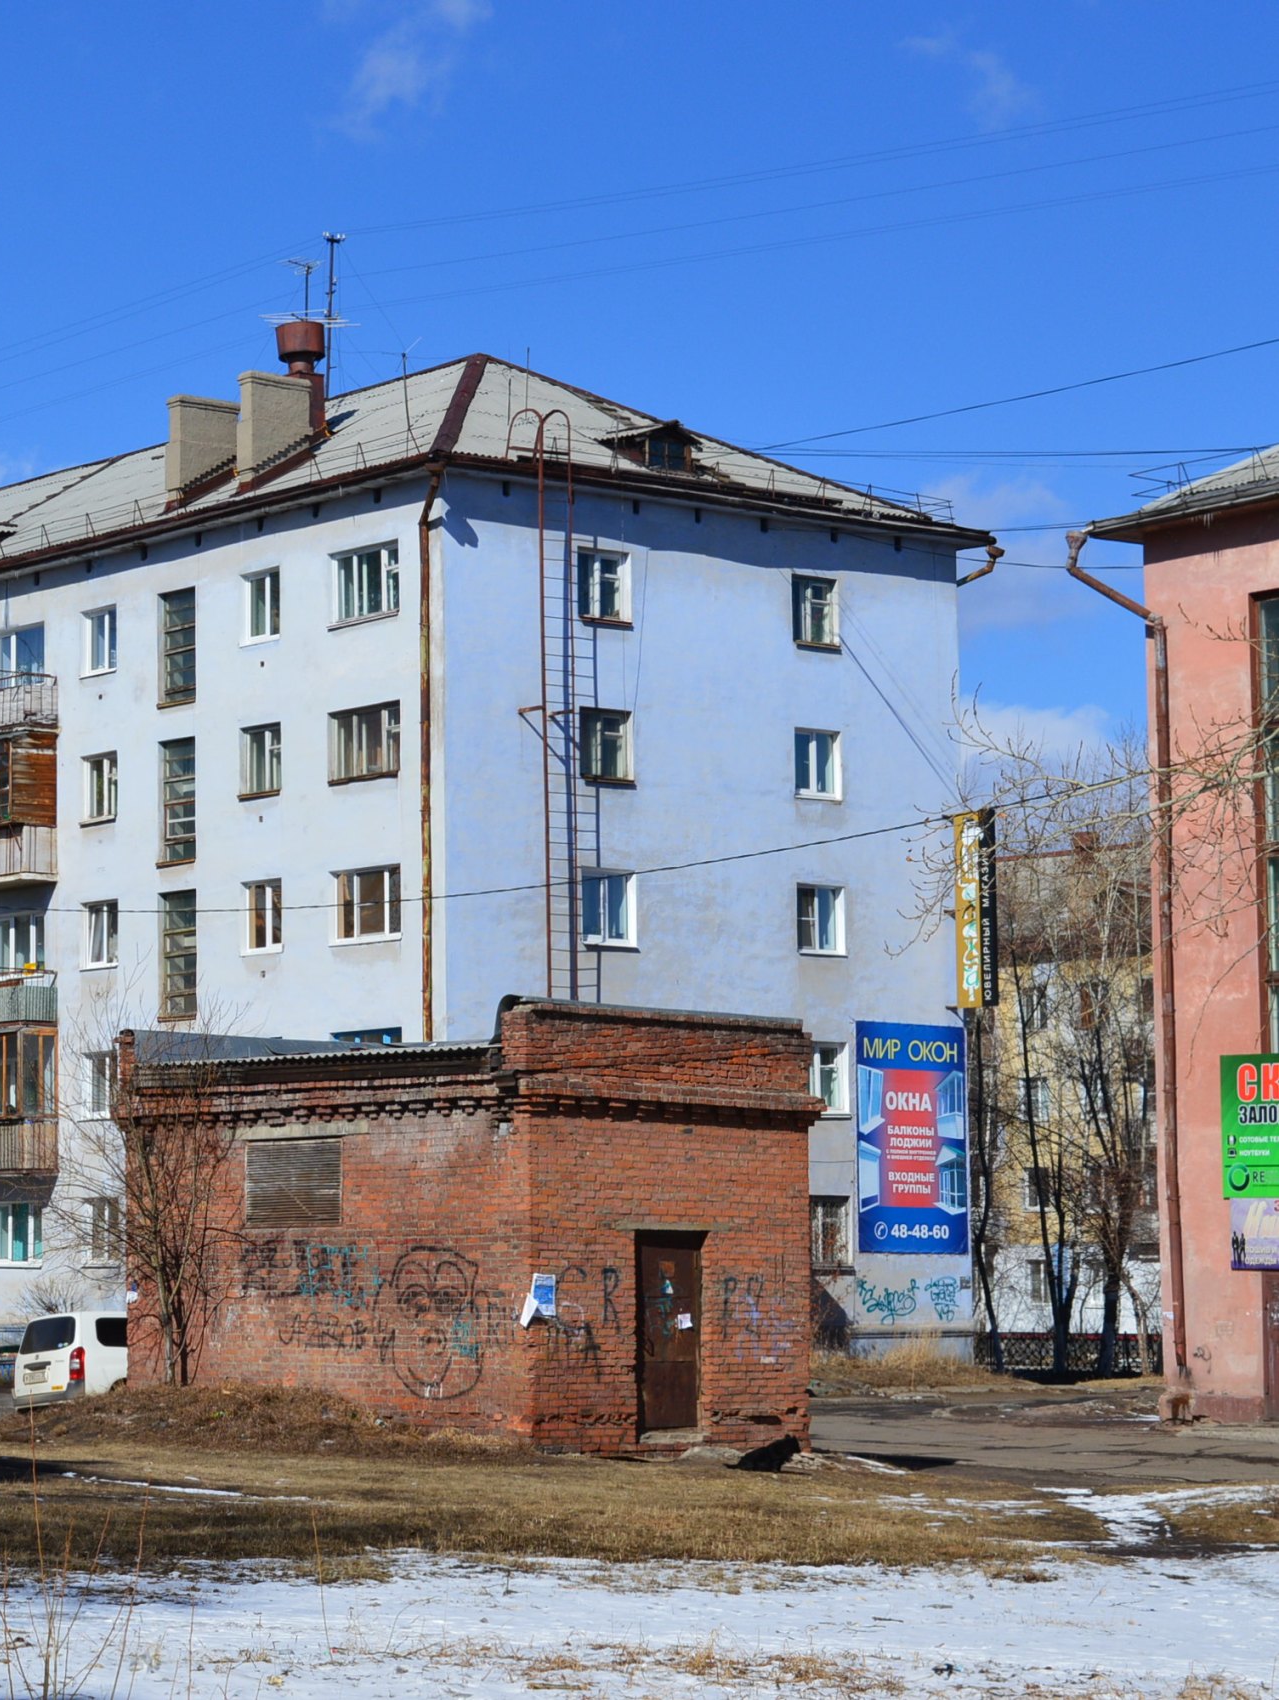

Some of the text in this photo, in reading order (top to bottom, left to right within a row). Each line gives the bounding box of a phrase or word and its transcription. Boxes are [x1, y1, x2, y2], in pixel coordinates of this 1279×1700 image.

[982, 918, 993, 1001] ЮВЕЛИРНЫЙ
[863, 1037, 958, 1063] МИР ОКОН
[885, 1091, 933, 1112] ОКНА
[887, 1125, 935, 1137] БАЛКОНЫ
[889, 1137, 932, 1148] ЛОДЖИИ
[1239, 1149, 1270, 1157] НОУТБУКИ
[888, 1172, 935, 1183] ВХОДНЫЕ
[892, 1184, 931, 1194] ГРУППЫ
[891, 1224, 950, 1240] 48-48-60
